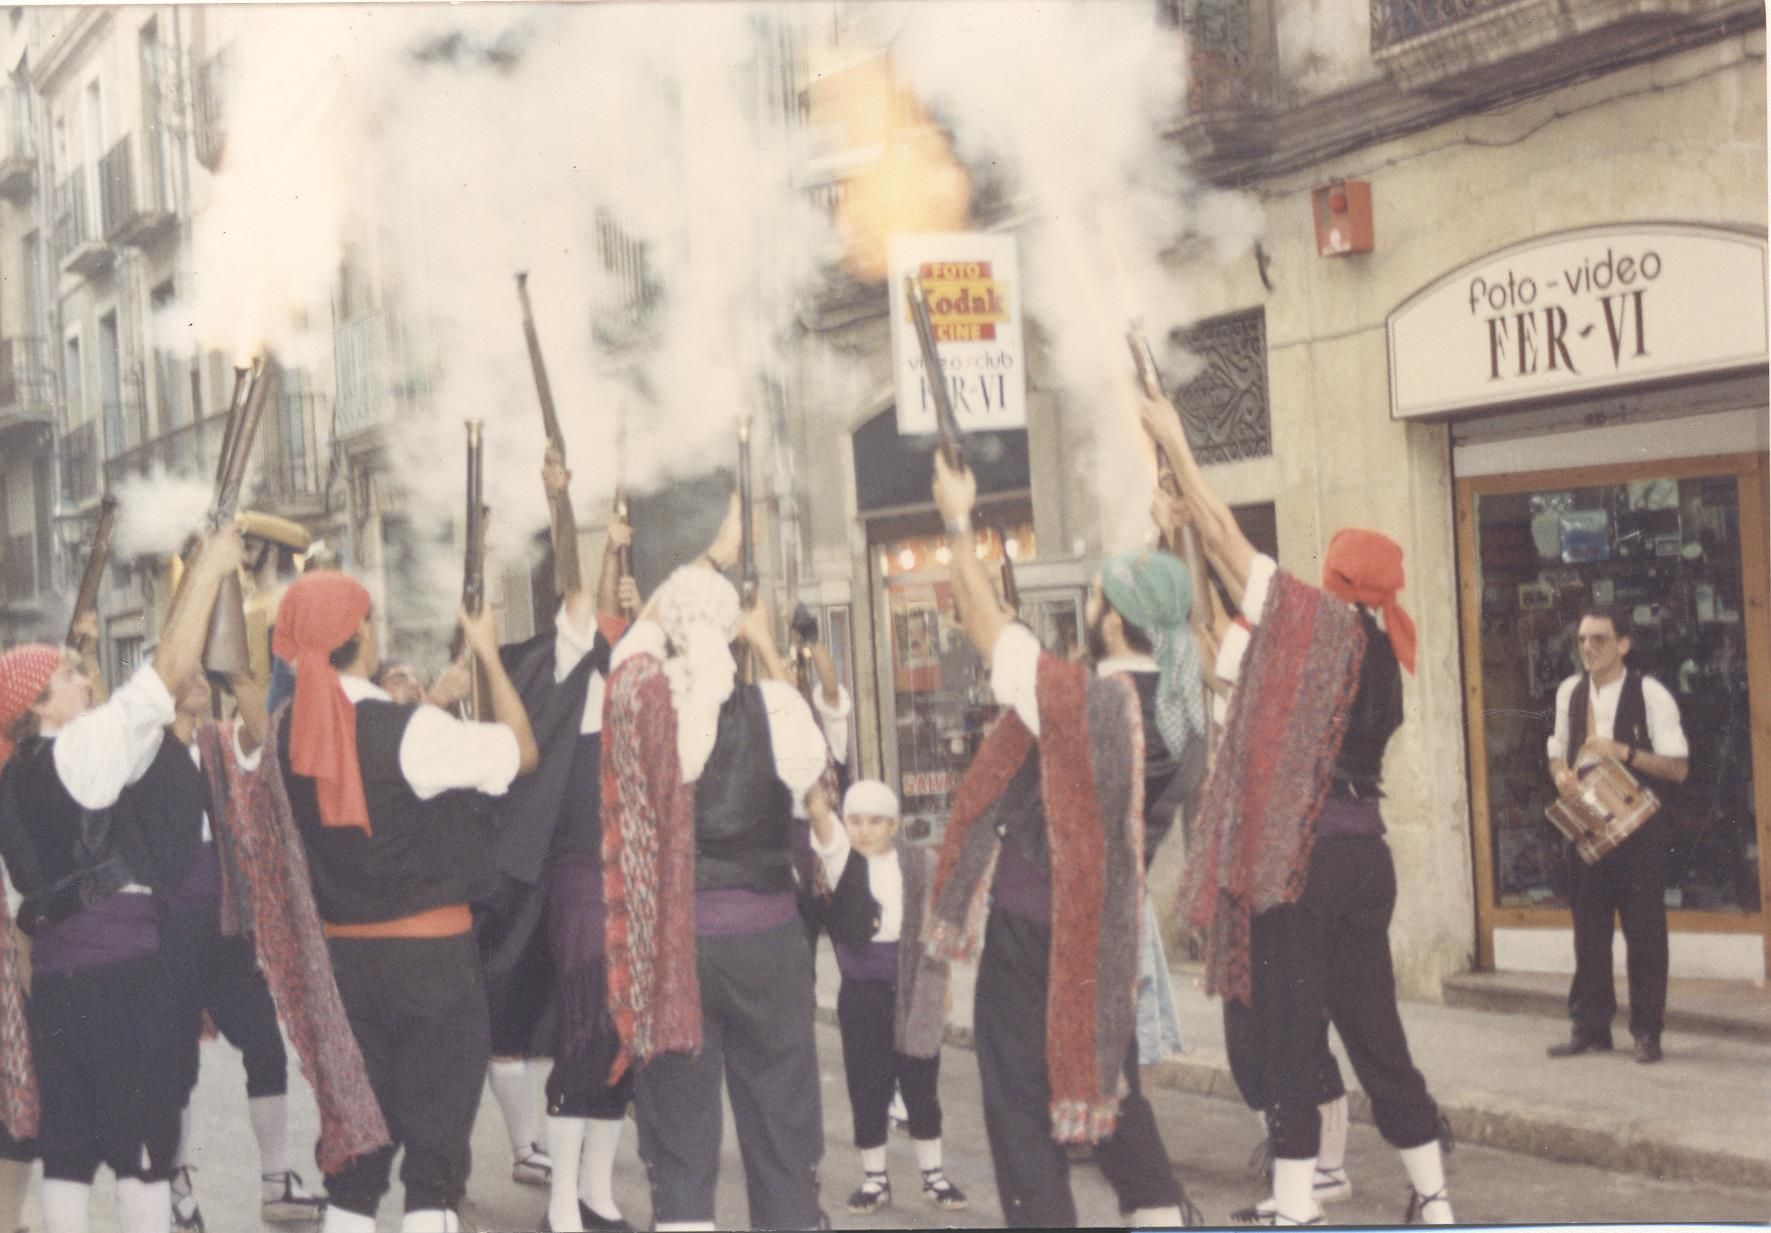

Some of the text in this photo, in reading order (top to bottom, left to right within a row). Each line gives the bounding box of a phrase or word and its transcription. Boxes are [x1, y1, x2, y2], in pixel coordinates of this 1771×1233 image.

[931, 263, 980, 279] FOTO
[1468, 267, 1537, 314] foto
[1563, 247, 1662, 296] video
[937, 325, 981, 340] CINE
[1486, 289, 1649, 381] FER-VI
[974, 350, 1015, 370] club
